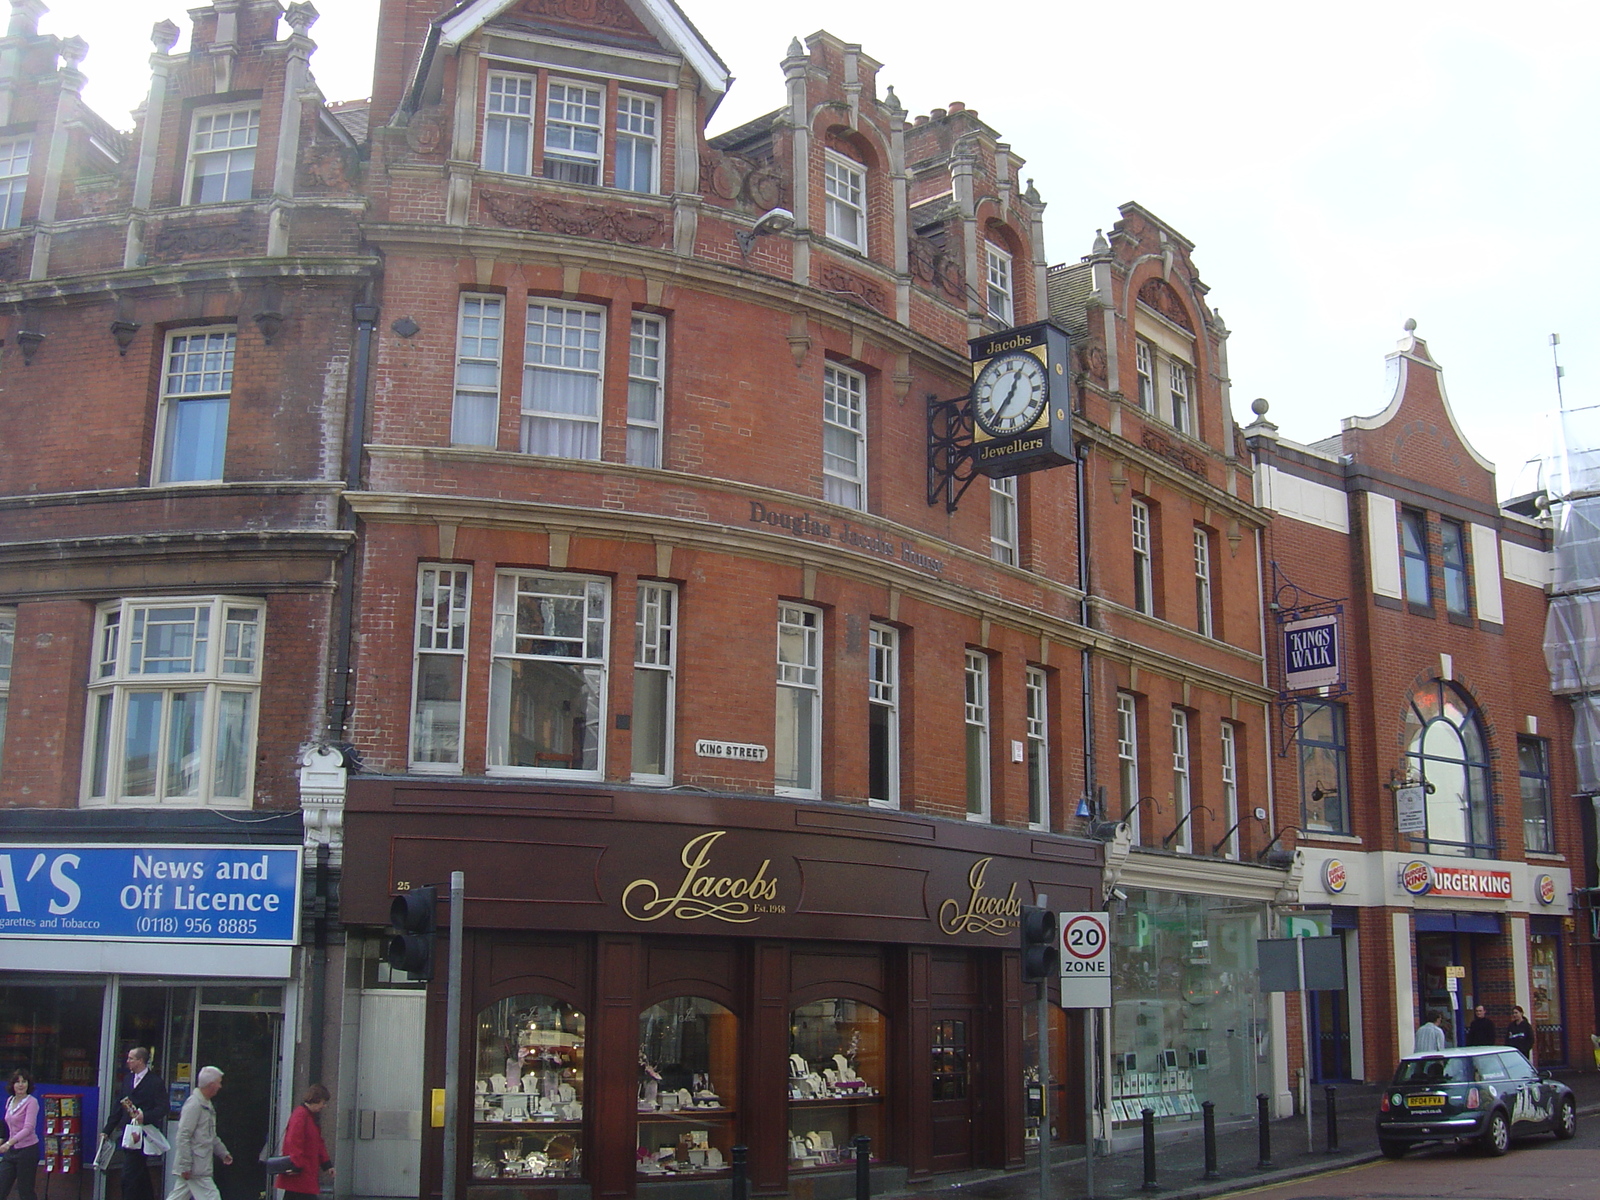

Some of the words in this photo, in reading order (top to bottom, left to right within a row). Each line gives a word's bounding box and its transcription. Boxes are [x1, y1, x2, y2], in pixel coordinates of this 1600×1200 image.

[986, 335, 1032, 355] Jacobs
[981, 438, 1044, 460] Jewellers
[749, 501, 831, 538] Douglas
[839, 523, 894, 556] Jacobs
[901, 542, 945, 573] House
[1290, 628, 1330, 653] KINGS
[1291, 646, 1331, 669] WALK
[699, 743, 722, 754] KING
[726, 745, 765, 759] STREET
[132, 855, 204, 880] News
[216, 855, 269, 881] and
[622, 830, 778, 923] Jacobs
[1404, 866, 1427, 880] BURGER
[397, 881, 410, 891] 25
[1405, 872, 1428, 888] KING
[1434, 872, 1478, 892] URGER
[1479, 875, 1511, 895] KING
[120, 885, 163, 910] Off
[174, 885, 280, 912] Licence
[939, 857, 1020, 936] Jacobs
[40, 917, 58, 928] and
[61, 917, 100, 929] Tobacco
[136, 916, 179, 934] (0118)
[185, 917, 212, 934] 956
[218, 918, 257, 935] 8885
[1071, 929, 1099, 946] 20
[1065, 961, 1105, 972] ZONE
[1410, 1097, 1427, 1105] RF04
[1428, 1096, 1442, 1104] FVA
